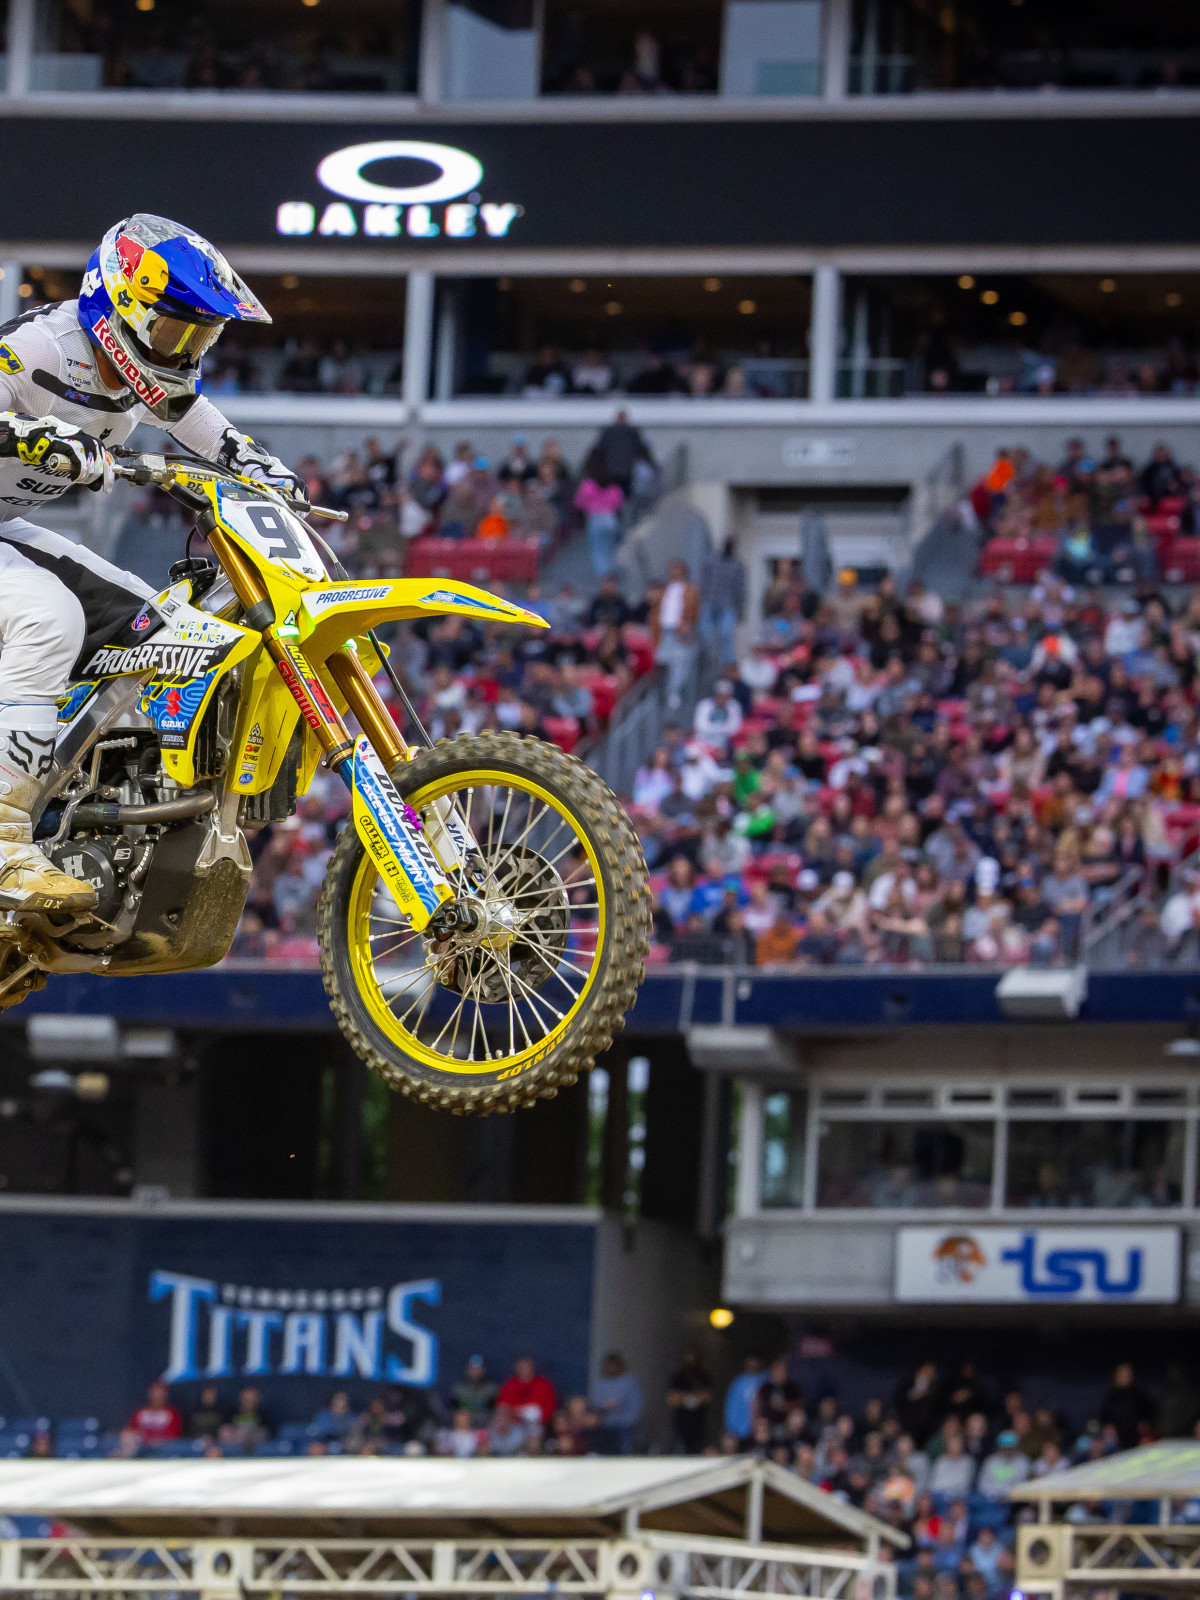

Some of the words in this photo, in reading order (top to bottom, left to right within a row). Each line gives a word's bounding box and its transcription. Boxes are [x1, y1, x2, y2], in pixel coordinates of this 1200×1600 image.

[276, 201, 518, 237] OAKLEY
[93, 317, 127, 367] Red
[124, 362, 166, 406] Bull
[316, 587, 389, 604] PROGRESSIVE
[174, 631, 192, 641] STOP
[193, 632, 226, 645] CANCER
[176, 621, 195, 630] LOVE
[81, 644, 215, 678] PROGRESSIVE
[278, 660, 322, 730] SHOWA
[160, 719, 185, 729] SUZUKI
[360, 815, 390, 859] GALFER
[374, 771, 446, 877] DUNLOP
[34, 896, 64, 910] FOX
[496, 1029, 567, 1081] DUNLOP
[1002, 1231, 1142, 1294] tsu
[148, 1268, 442, 1389] TITANS
